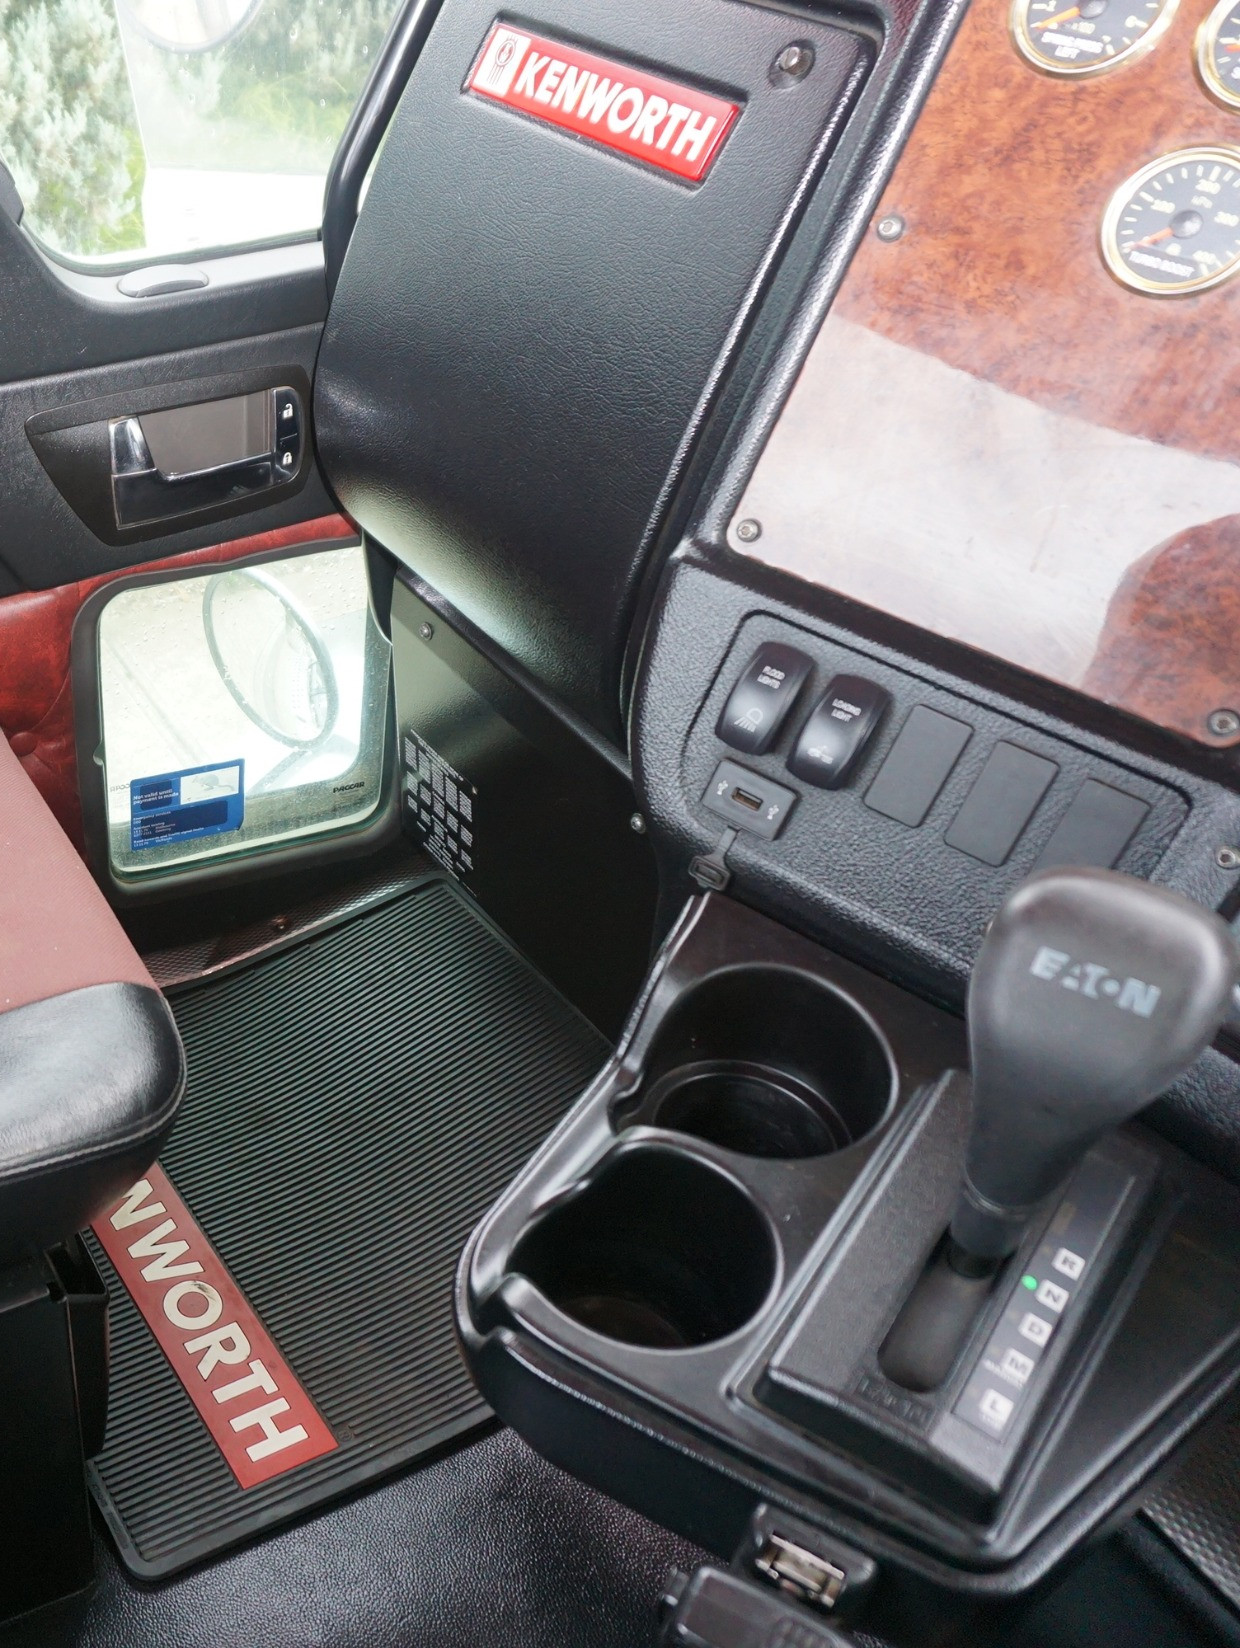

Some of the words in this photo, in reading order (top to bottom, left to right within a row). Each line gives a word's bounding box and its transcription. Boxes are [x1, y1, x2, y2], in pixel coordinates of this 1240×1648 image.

[514, 52, 717, 162] KENWORTH
[333, 781, 365, 793] PACCAR
[1029, 946, 1161, 1019] EATON
[110, 1178, 310, 1463] NWORTH
